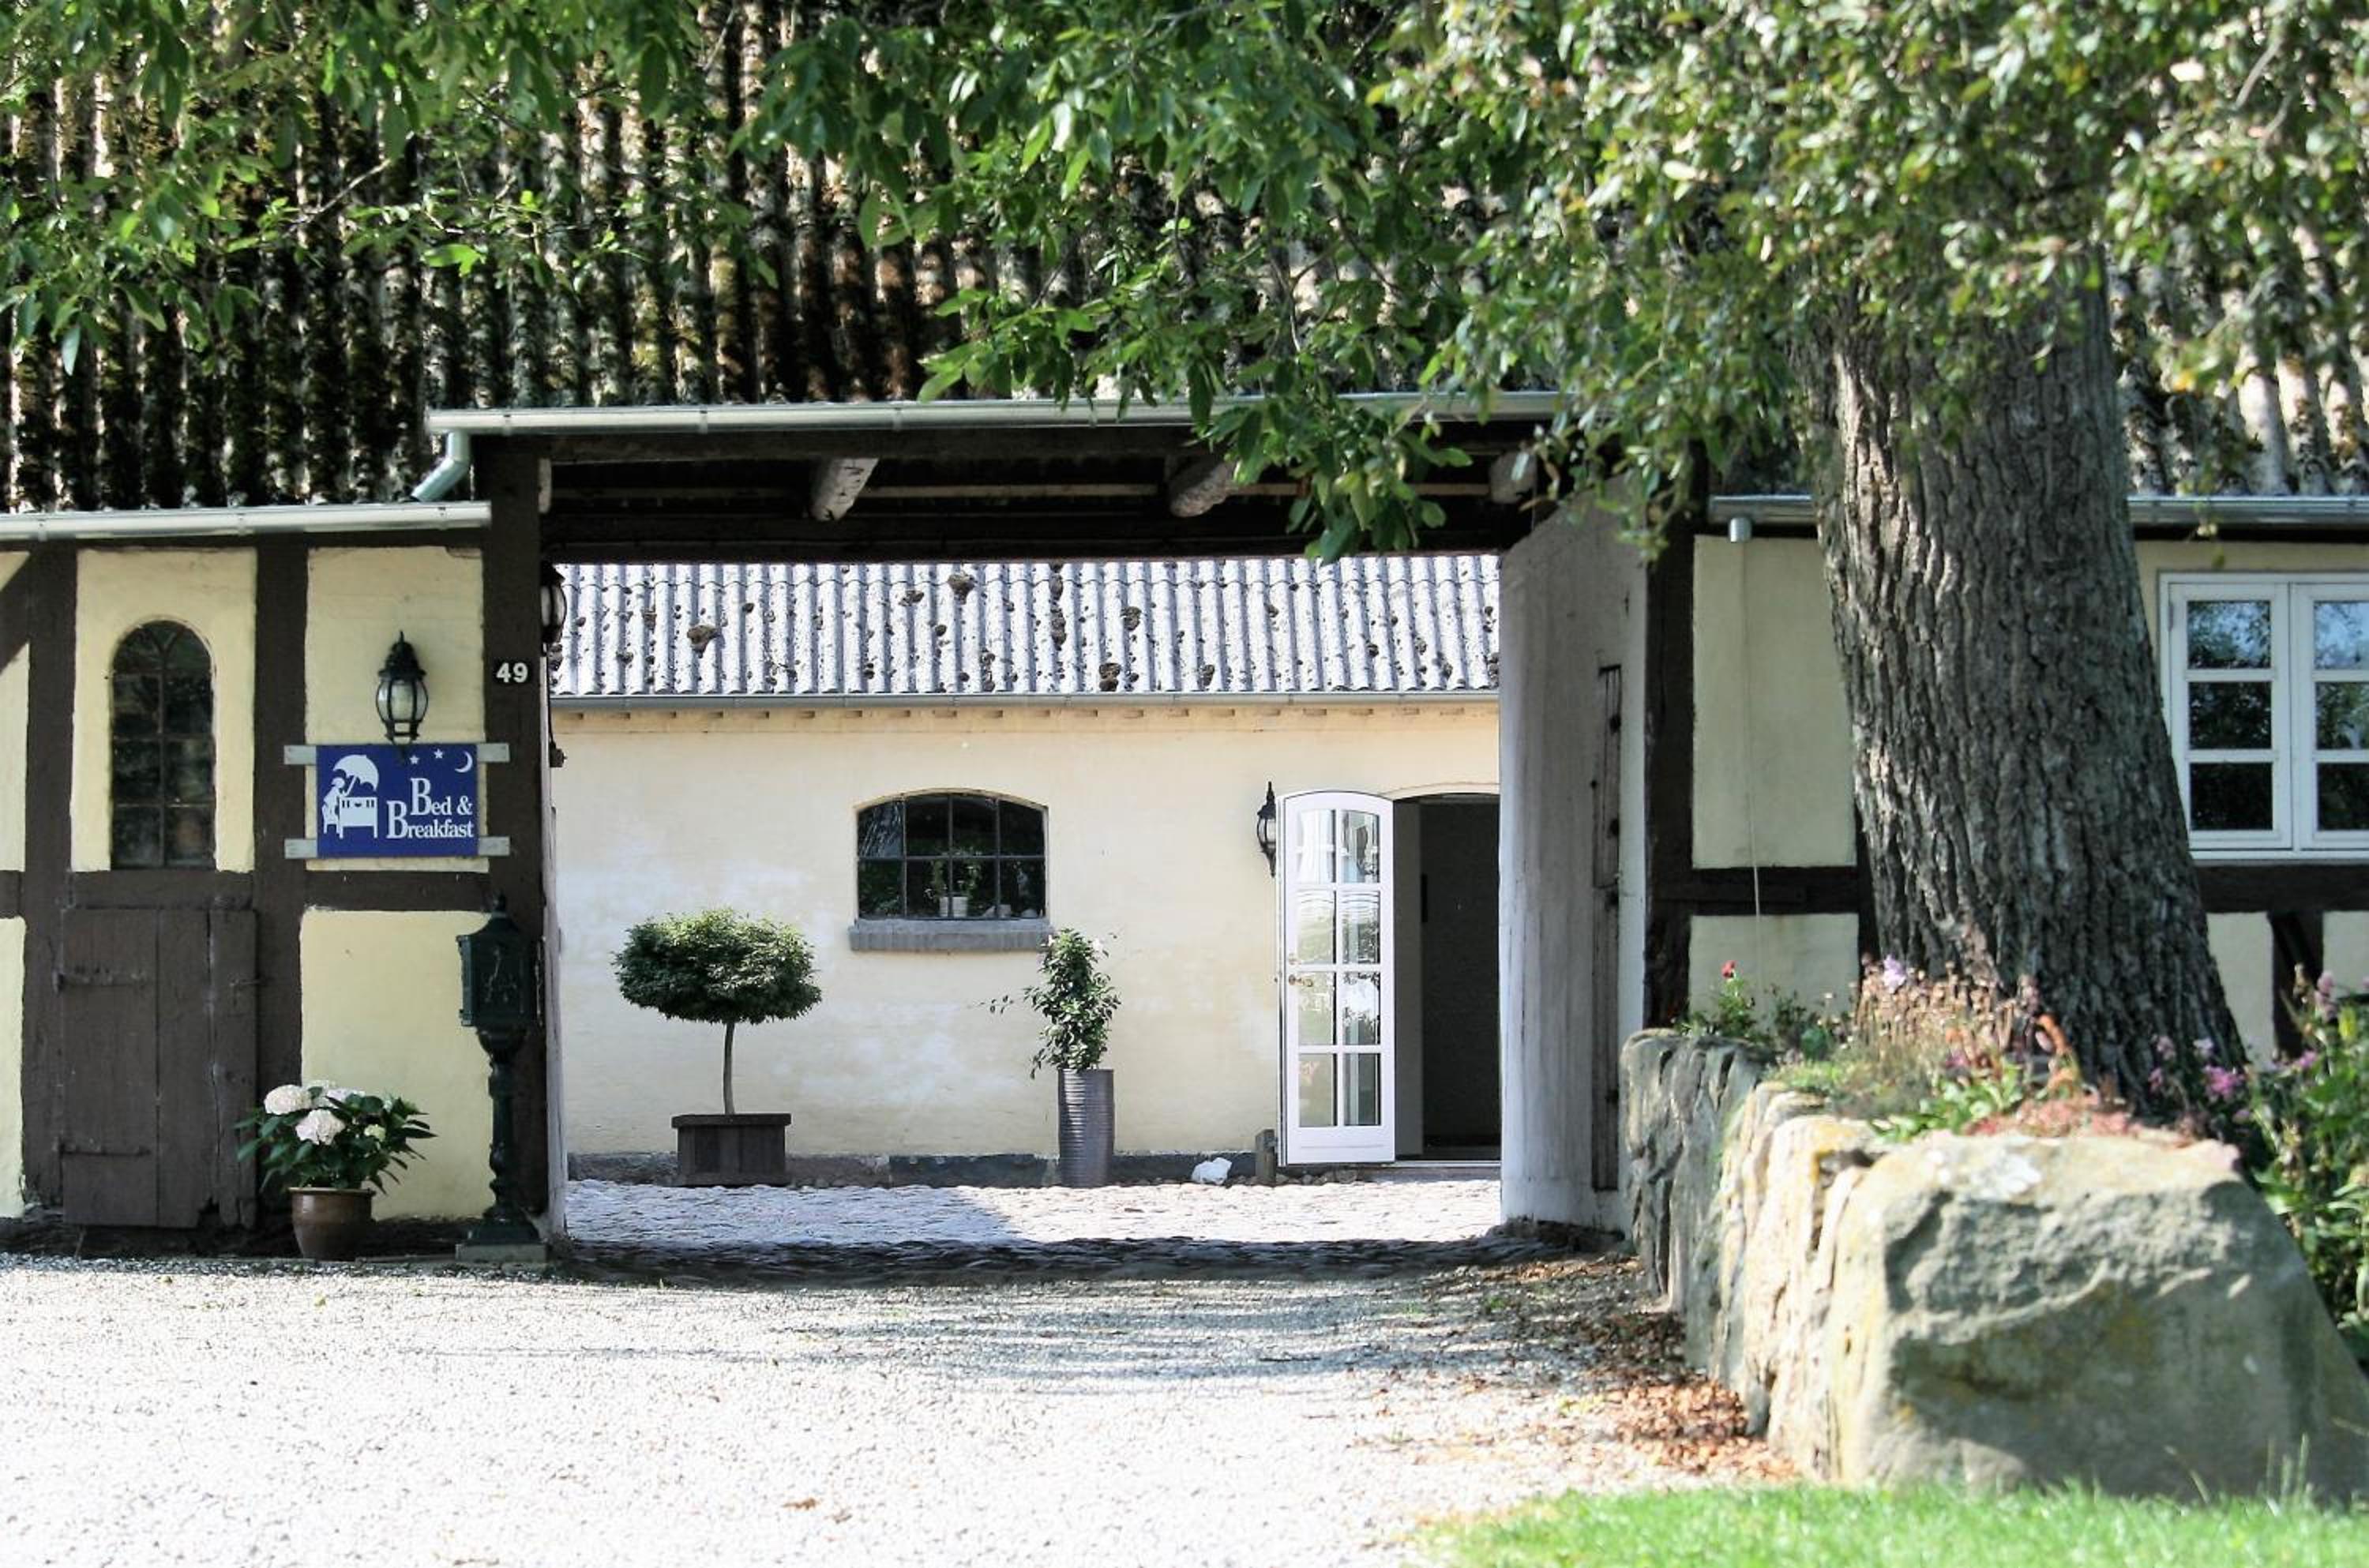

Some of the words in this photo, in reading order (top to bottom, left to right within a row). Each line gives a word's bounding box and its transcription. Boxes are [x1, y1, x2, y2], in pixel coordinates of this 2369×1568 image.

[496, 662, 528, 683] 49
[411, 777, 452, 816] Bed
[456, 796, 473, 816] &
[385, 800, 475, 839] Breakfast
